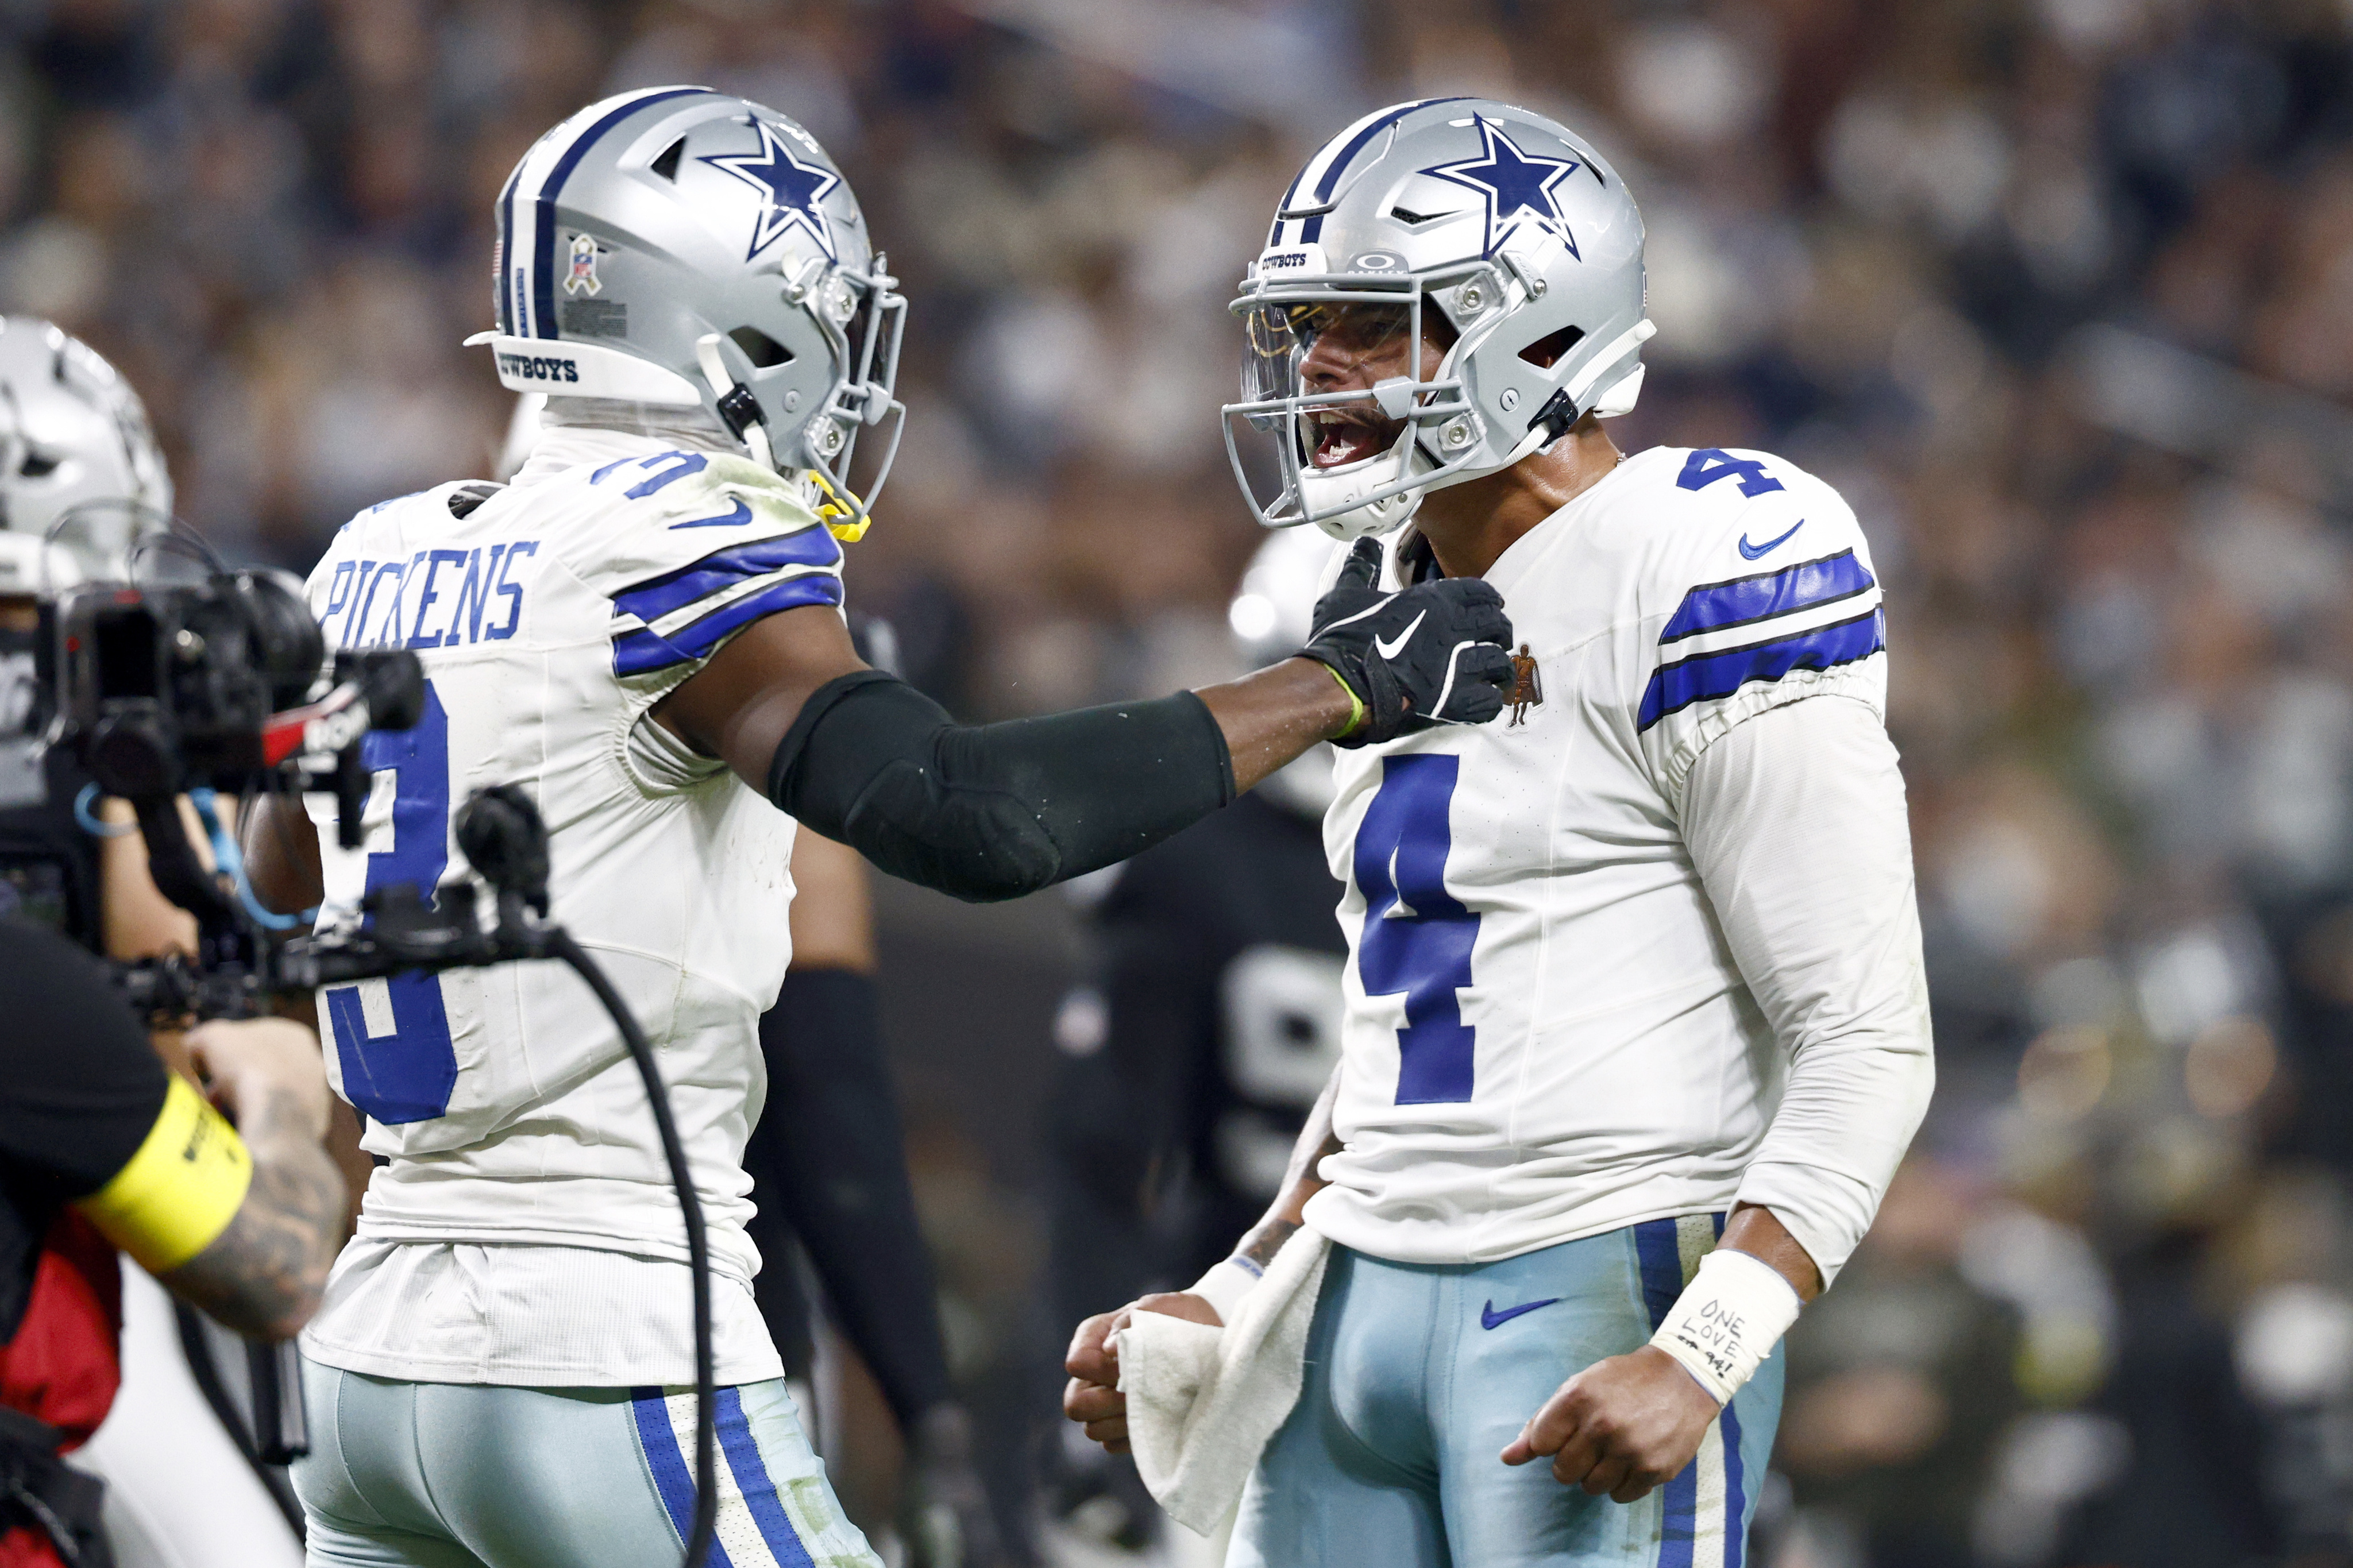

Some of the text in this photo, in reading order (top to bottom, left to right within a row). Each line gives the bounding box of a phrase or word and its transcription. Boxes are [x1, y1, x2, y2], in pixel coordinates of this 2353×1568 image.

[1262, 253, 1307, 271] COWBOYS
[1676, 448, 1786, 499] 4
[319, 540, 540, 651] PICKENS
[1353, 753, 1481, 1105] 4
[1681, 1316, 1740, 1360] LOVE
[1700, 1299, 1745, 1339] ONE
